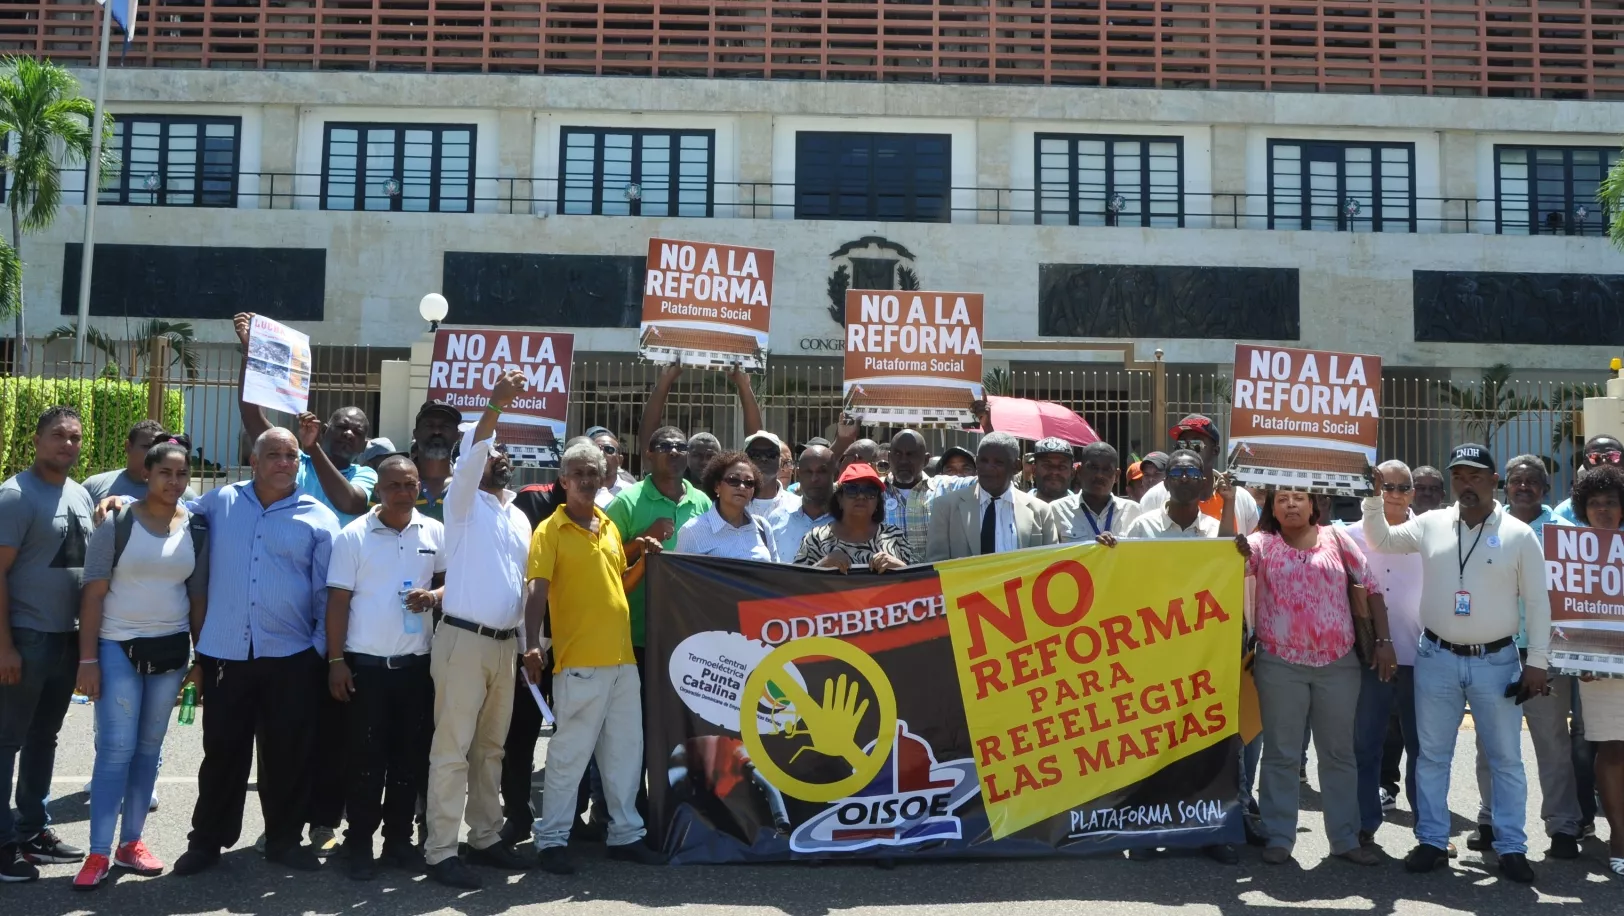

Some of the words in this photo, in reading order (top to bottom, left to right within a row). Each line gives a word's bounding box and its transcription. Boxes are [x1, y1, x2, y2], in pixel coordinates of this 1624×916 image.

[660, 243, 696, 272] NO
[701, 248, 720, 274] A
[727, 250, 759, 278] LA
[646, 270, 768, 306] REFORMA
[661, 301, 717, 318] Plataforma
[720, 306, 751, 321] Social
[861, 294, 899, 323] NO
[906, 296, 927, 324] A
[934, 296, 970, 325] LA
[446, 333, 486, 361] NO
[491, 335, 512, 362] A
[520, 335, 556, 364] LA
[847, 324, 982, 355] REFORMA
[865, 356, 927, 371] Plataforma
[930, 358, 964, 372] Social
[1250, 349, 1291, 381] NO
[1298, 353, 1320, 383] A
[1329, 355, 1367, 386] LA
[511, 396, 546, 410] Social
[1234, 379, 1379, 418] REFORMA
[1252, 414, 1319, 433] Plataforma
[1322, 420, 1359, 435] Social
[1557, 529, 1599, 562] NO
[1607, 534, 1624, 564] A
[1544, 560, 1624, 597] REFO
[761, 594, 947, 645] ODEBRECH
[956, 559, 1095, 660] NO
[969, 589, 1230, 700] REFORMA
[688, 652, 744, 679] Termoeléctrica
[701, 668, 740, 690] Punta
[718, 655, 747, 671] Central
[683, 674, 737, 701] Catalina
[1026, 661, 1135, 714] PARA
[975, 669, 1216, 767] REEELEGIR
[983, 754, 1063, 804] LAS
[1073, 702, 1227, 777] MAFIAS
[837, 793, 951, 825] OISOE
[1070, 803, 1172, 832] PLATAFORMA
[1178, 799, 1227, 824] SOCIAL
